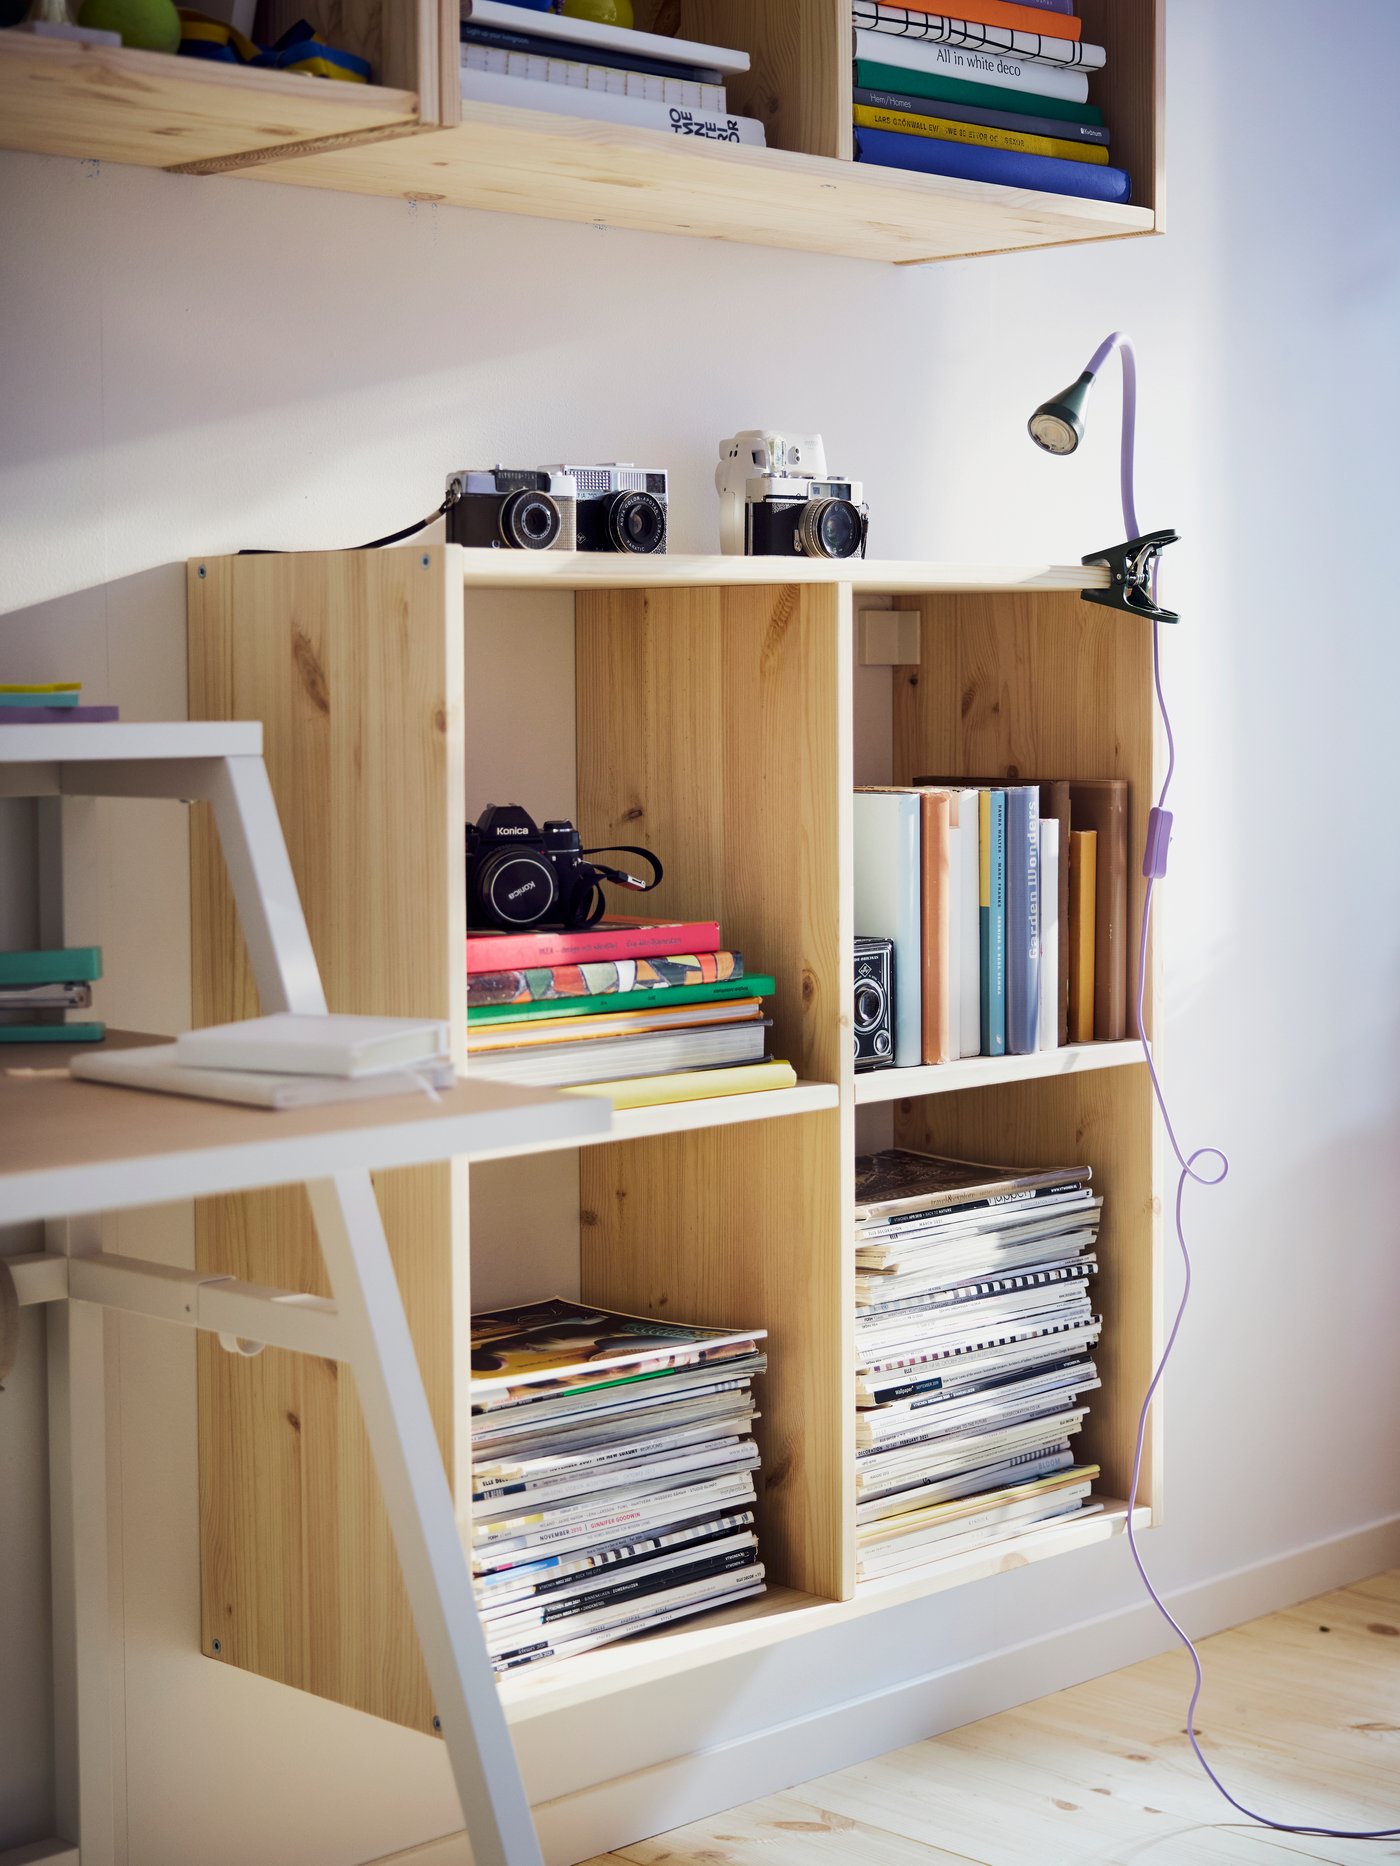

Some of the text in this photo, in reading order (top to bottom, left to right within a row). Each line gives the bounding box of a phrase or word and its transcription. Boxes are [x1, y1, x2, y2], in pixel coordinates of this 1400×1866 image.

[937, 48, 1021, 77] All in white deco
[496, 826, 529, 836] Konica
[508, 880, 536, 900] Konica
[1028, 891, 1038, 959] Garden
[899, 1437, 919, 1446] FEBRUARY
[1038, 1457, 1060, 1471] BLOOM
[482, 1479, 494, 1487] ELLE
[539, 1529, 570, 1541] NOVEMBER
[570, 1526, 582, 1535] 2010
[590, 1518, 615, 1529] GINNIFER
[616, 1511, 641, 1523] GOODWIN
